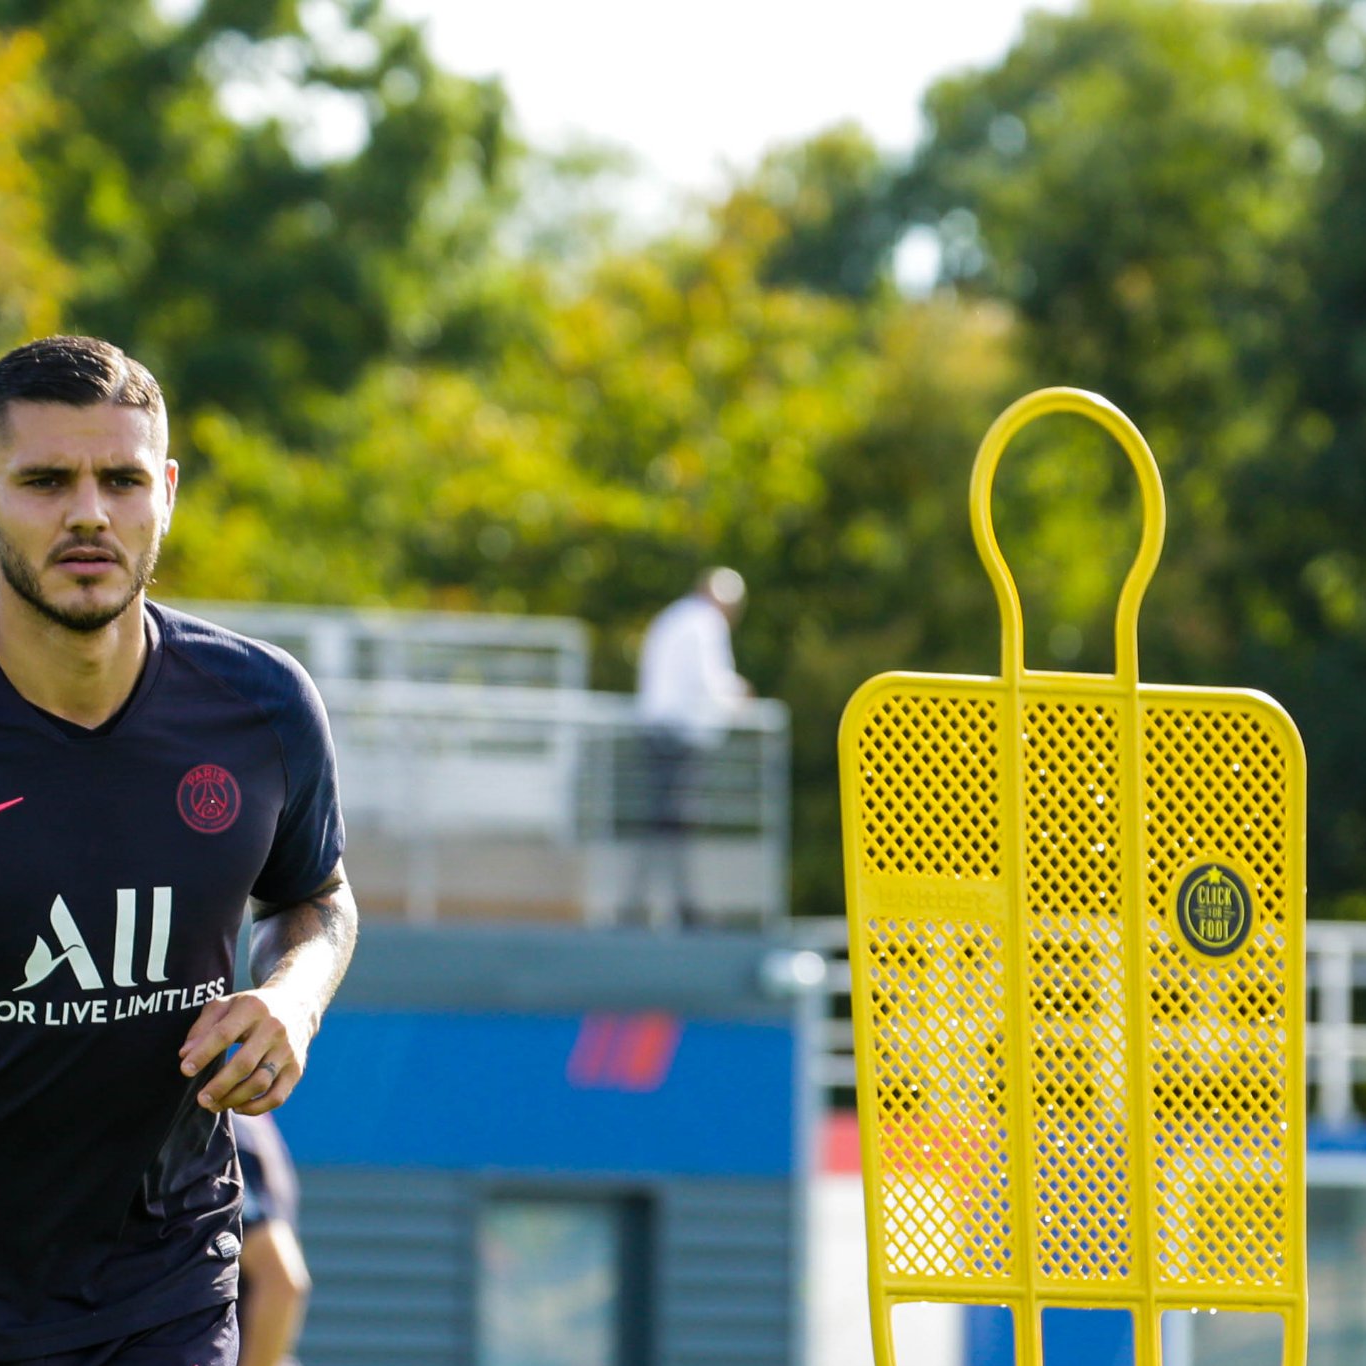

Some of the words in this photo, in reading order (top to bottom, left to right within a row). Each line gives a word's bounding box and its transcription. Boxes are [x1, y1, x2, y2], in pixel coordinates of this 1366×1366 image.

[185, 767, 229, 785] PARIS
[1197, 885, 1233, 906] CLICK
[1199, 919, 1230, 940] FOOT
[45, 1000, 107, 1026] LIVE
[114, 977, 226, 1021] LIMITLESS
